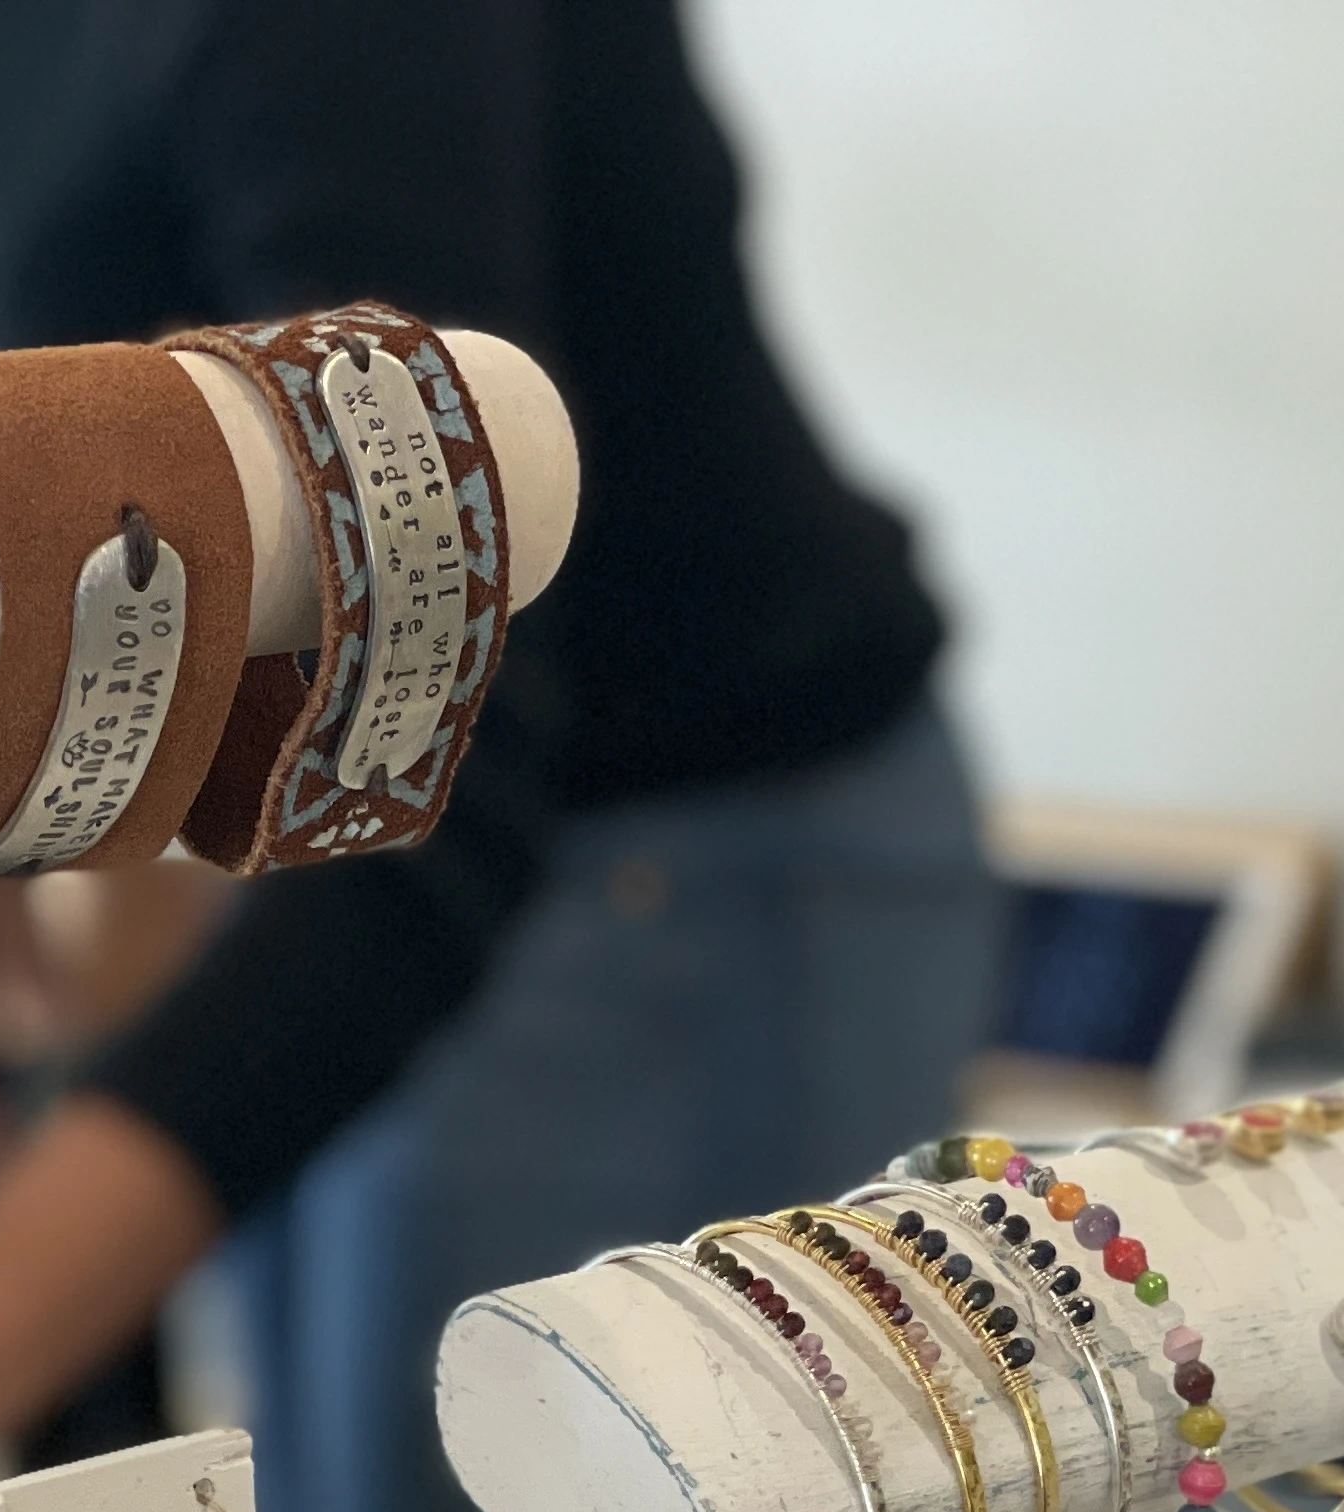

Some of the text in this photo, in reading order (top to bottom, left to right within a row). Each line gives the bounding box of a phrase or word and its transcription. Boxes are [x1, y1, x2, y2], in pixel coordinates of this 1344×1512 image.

[356, 384, 429, 741] wander are lost
[408, 432, 460, 698] not all who
[105, 604, 140, 695] YOUR
[149, 599, 172, 638] DO
[72, 715, 119, 792] SOUL
[114, 668, 163, 766] WHAT
